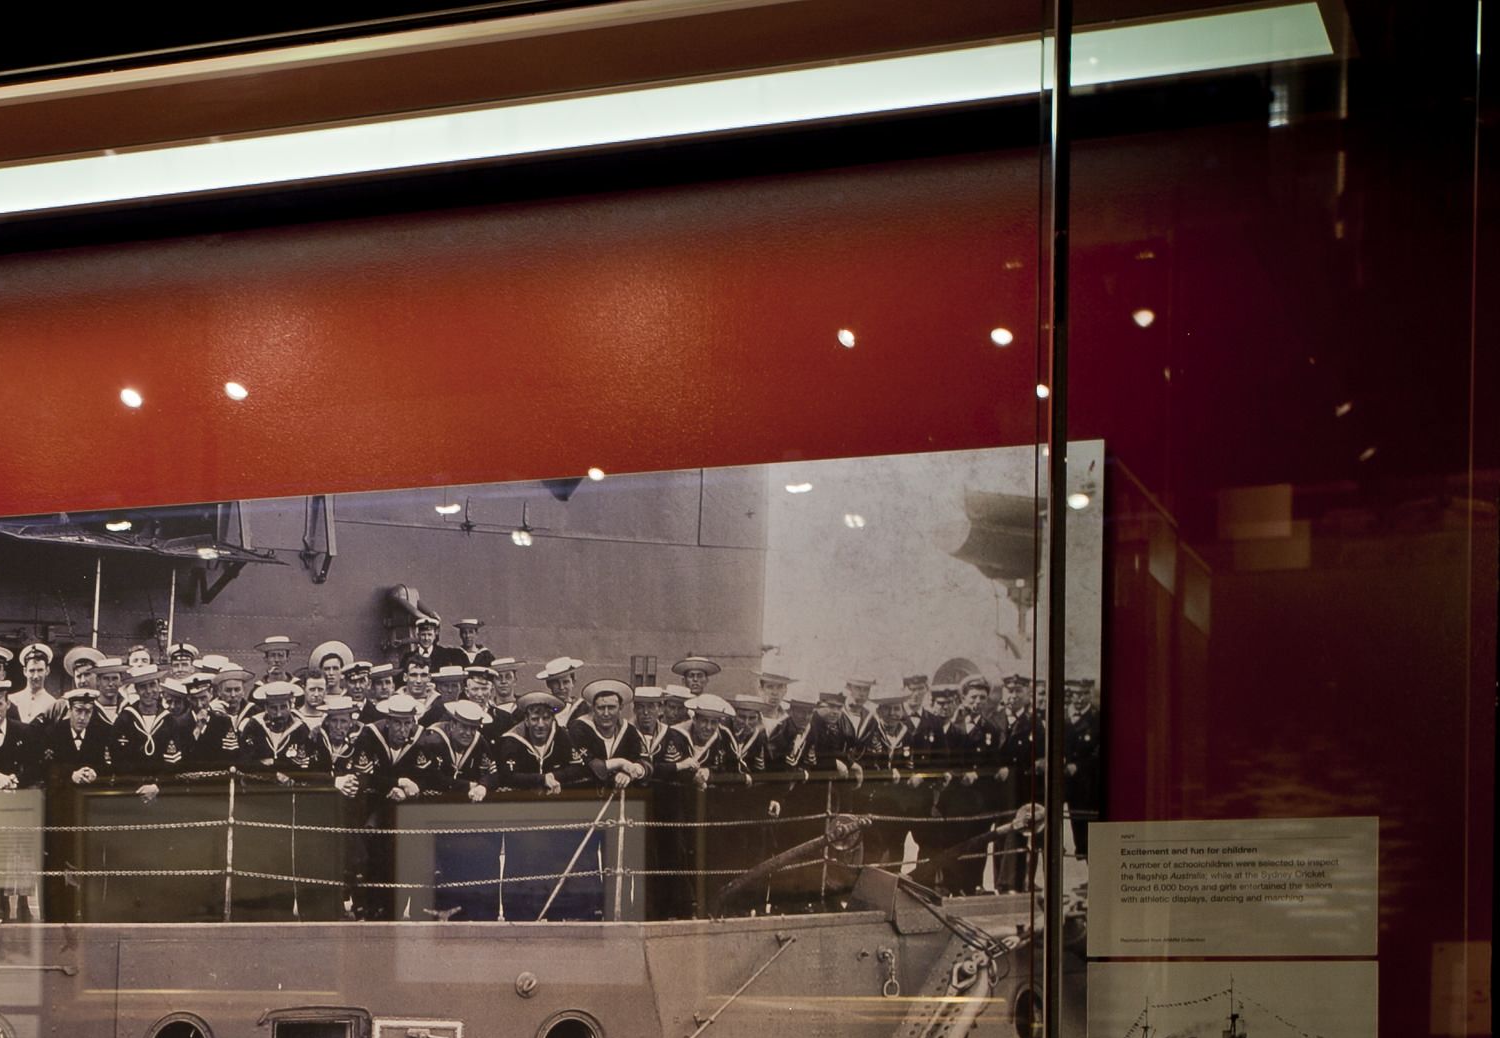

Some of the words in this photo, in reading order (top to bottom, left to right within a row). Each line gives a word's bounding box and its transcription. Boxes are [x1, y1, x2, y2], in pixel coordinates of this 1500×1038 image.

[1120, 847, 1169, 856] Excitement
[1172, 847, 1188, 855] and
[1222, 846, 1257, 854] children
[1129, 861, 1160, 869] number
[1173, 860, 1233, 868] schoolchildren
[1258, 859, 1293, 867] selected
[1308, 859, 1339, 868] inspect
[1121, 873, 1133, 881] the
[1136, 873, 1168, 882] flagship
[1246, 871, 1258, 879] the
[1261, 871, 1292, 881] Sydney
[1295, 870, 1325, 878] Cricket
[1121, 884, 1150, 892] Ground
[1179, 884, 1199, 893] boys
[1202, 883, 1217, 891] and
[1220, 883, 1236, 893] girls
[1239, 882, 1286, 890] entertained
[1140, 895, 1169, 903] athletic
[1211, 894, 1243, 904] dancing
